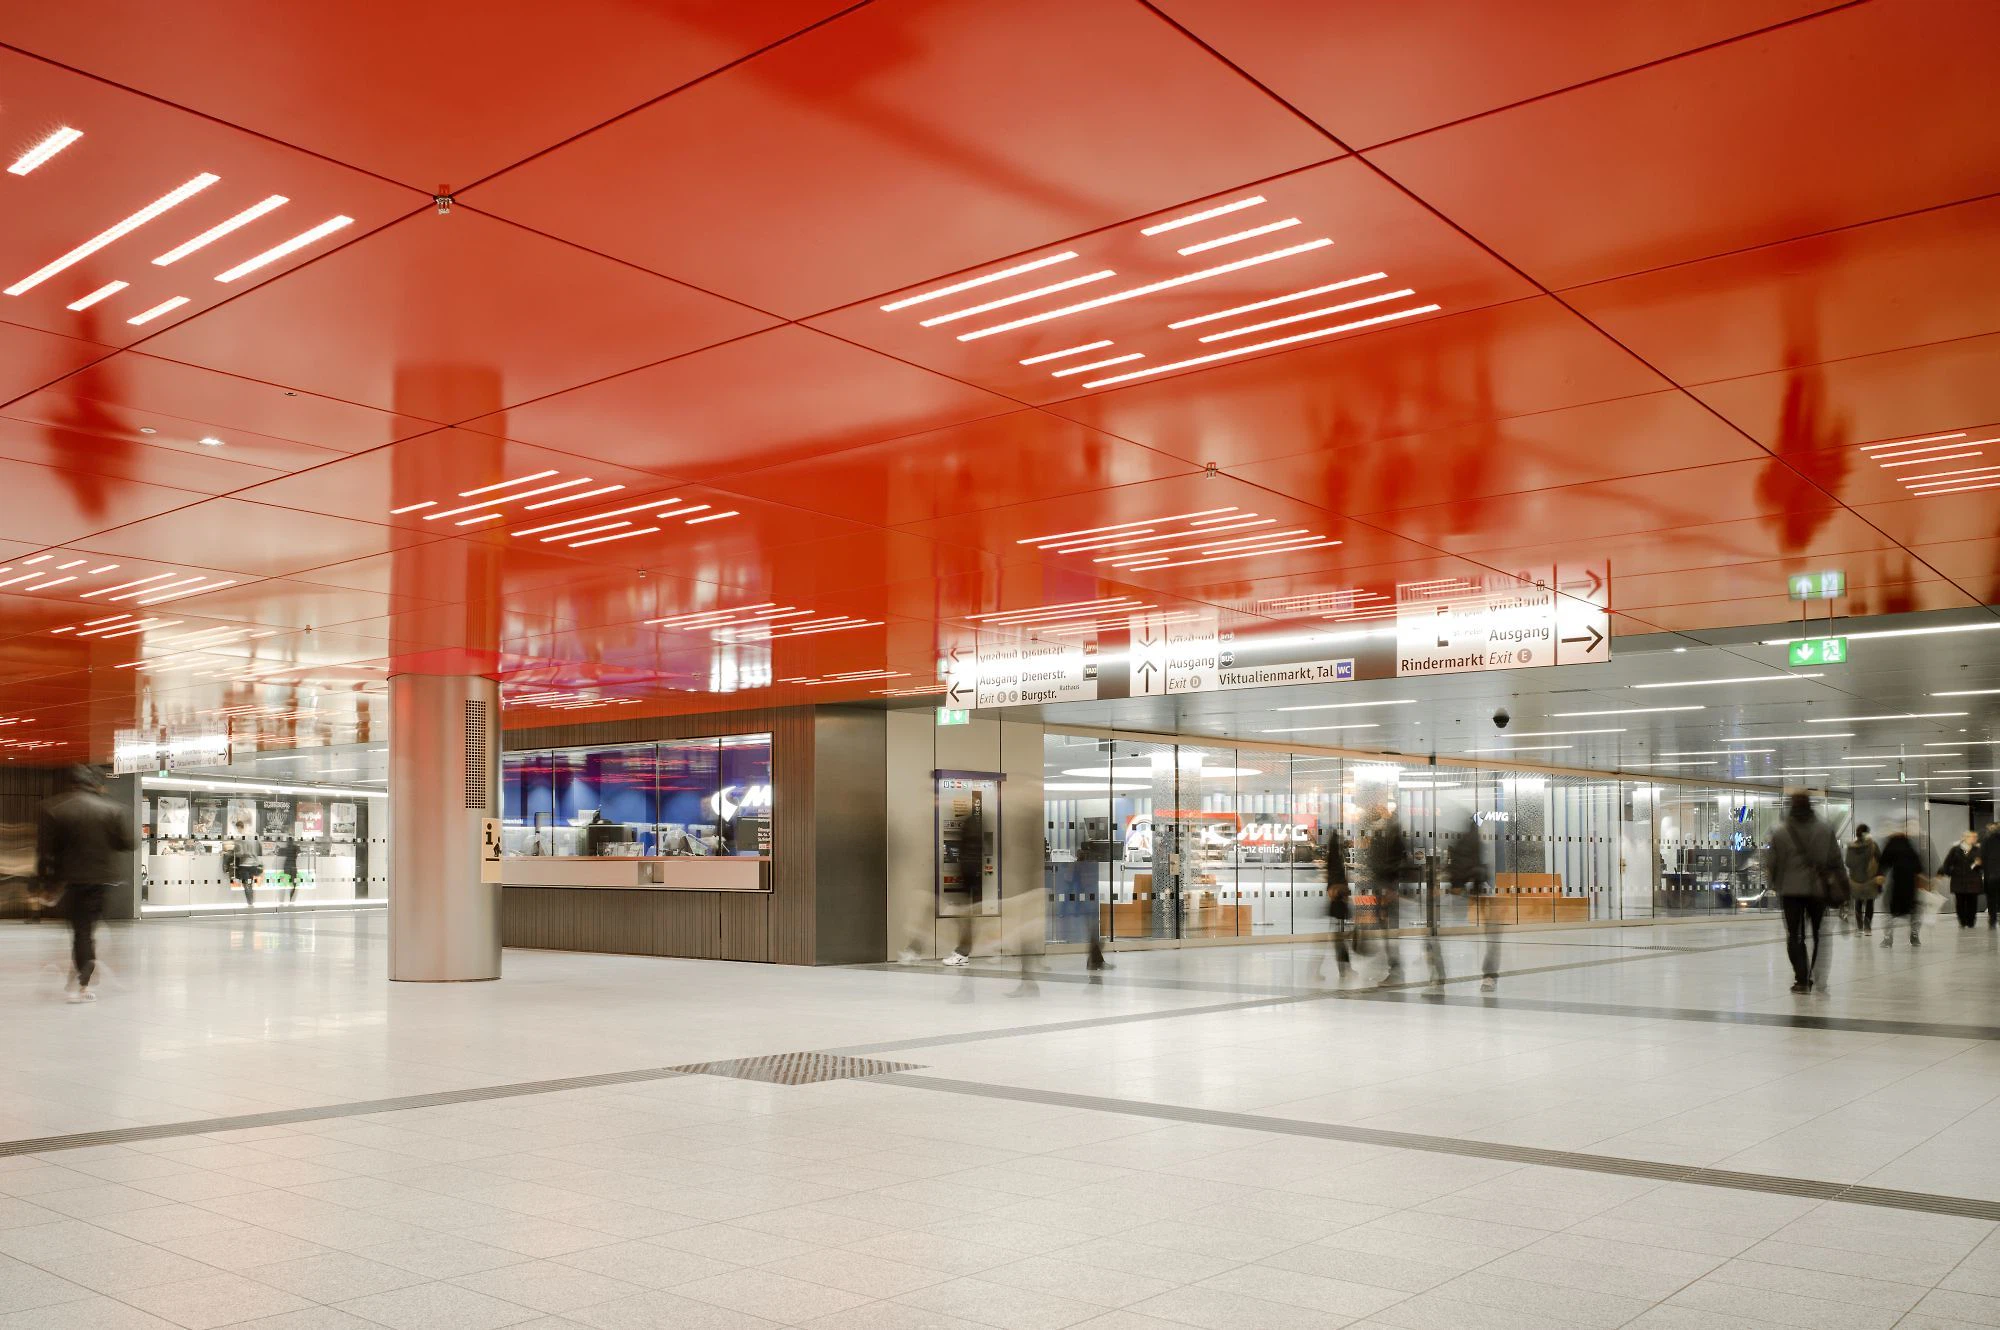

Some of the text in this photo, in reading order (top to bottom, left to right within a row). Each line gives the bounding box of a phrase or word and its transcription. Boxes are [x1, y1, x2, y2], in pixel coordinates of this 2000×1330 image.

[1489, 626, 1549, 642] Ausgang
[1169, 655, 1215, 671] Ausgang
[1221, 653, 1234, 663] BUS
[1400, 654, 1484, 671] Rindermarkt
[1489, 651, 1512, 665] Exit
[1219, 665, 1334, 686] Viktualienmarkt, Tal
[1336, 665, 1351, 675] WC
[979, 669, 1067, 687] Ausgang Dienerstr.
[1169, 677, 1187, 690] Exit
[979, 692, 994, 704] Exit
[1021, 690, 1057, 702] Burgstr.
[1484, 811, 1509, 822] MVG
[1236, 823, 1308, 841] MVG
[1258, 843, 1289, 854] einfac
